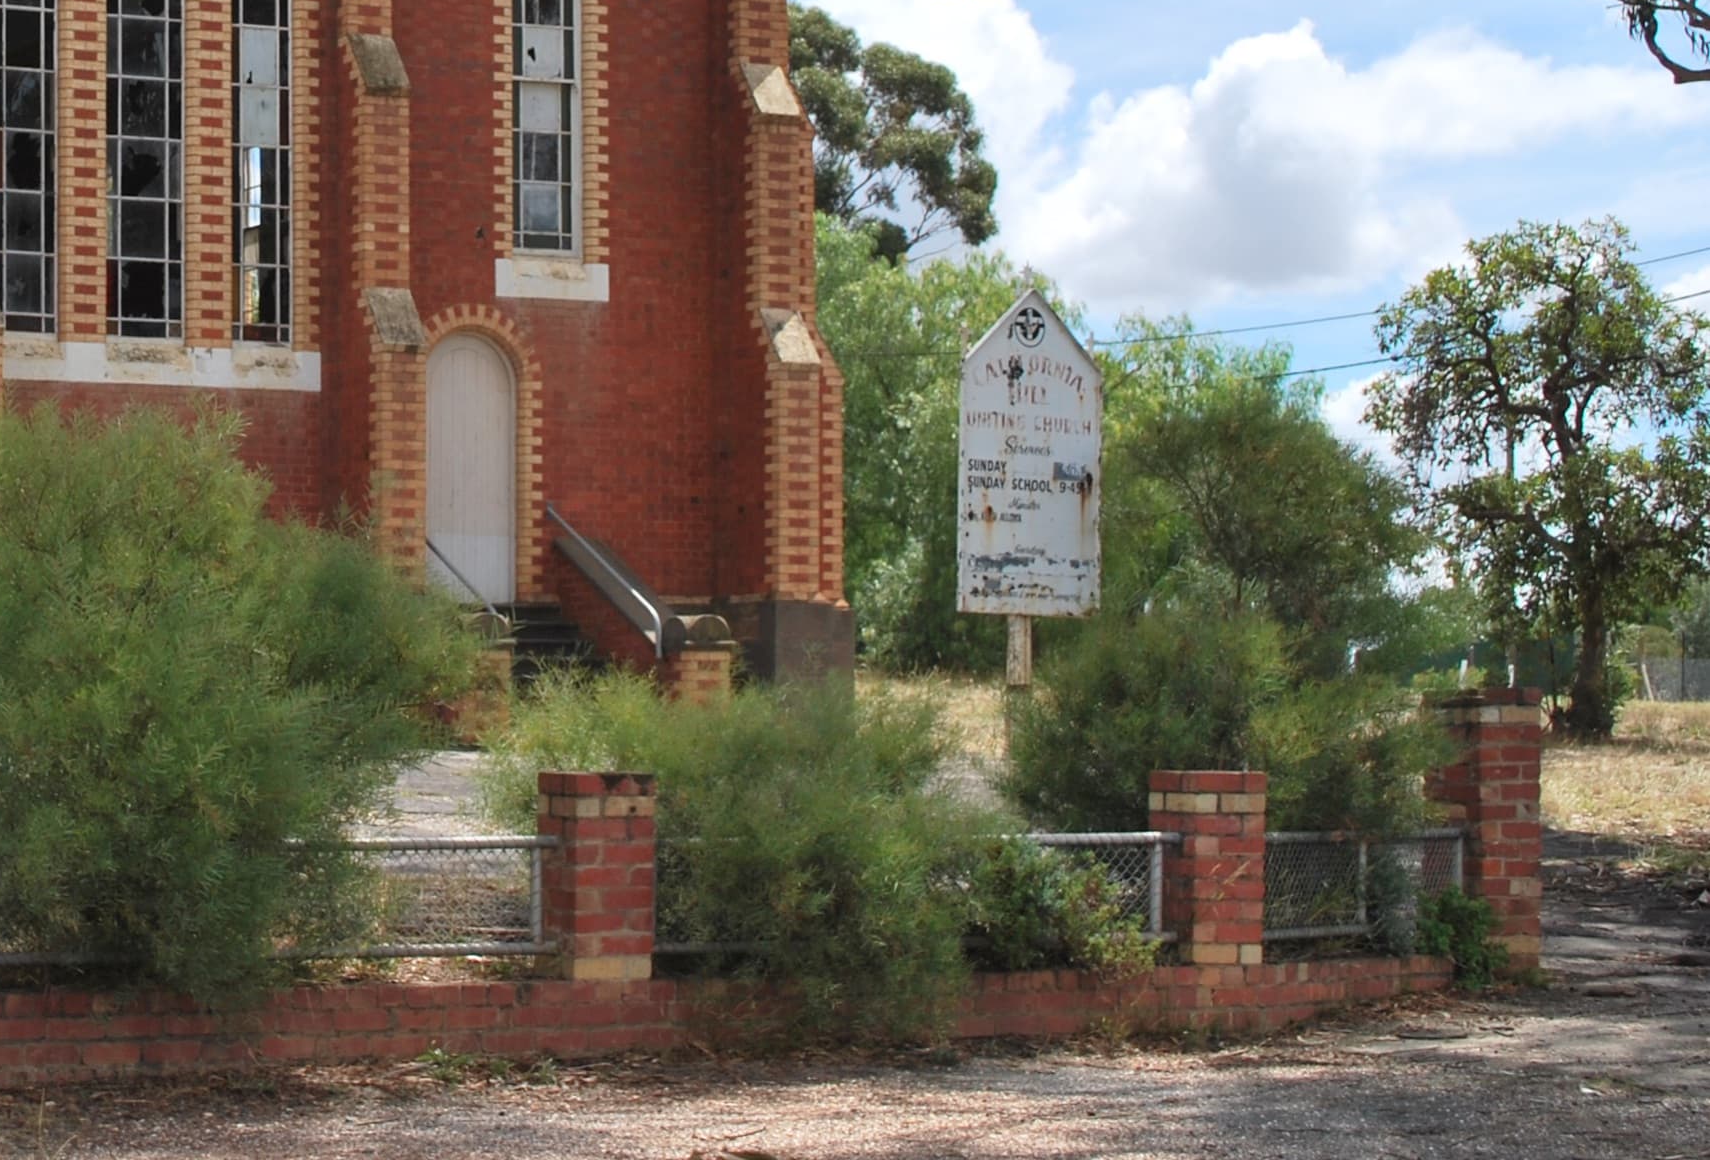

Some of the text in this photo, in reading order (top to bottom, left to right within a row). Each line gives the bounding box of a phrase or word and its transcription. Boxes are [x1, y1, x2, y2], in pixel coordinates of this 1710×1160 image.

[972, 354, 1083, 393] CALORNIA
[968, 458, 1007, 474] SUNDAY
[968, 475, 1006, 490] SUNDAY
[1011, 477, 1053, 494] SCHOOL
